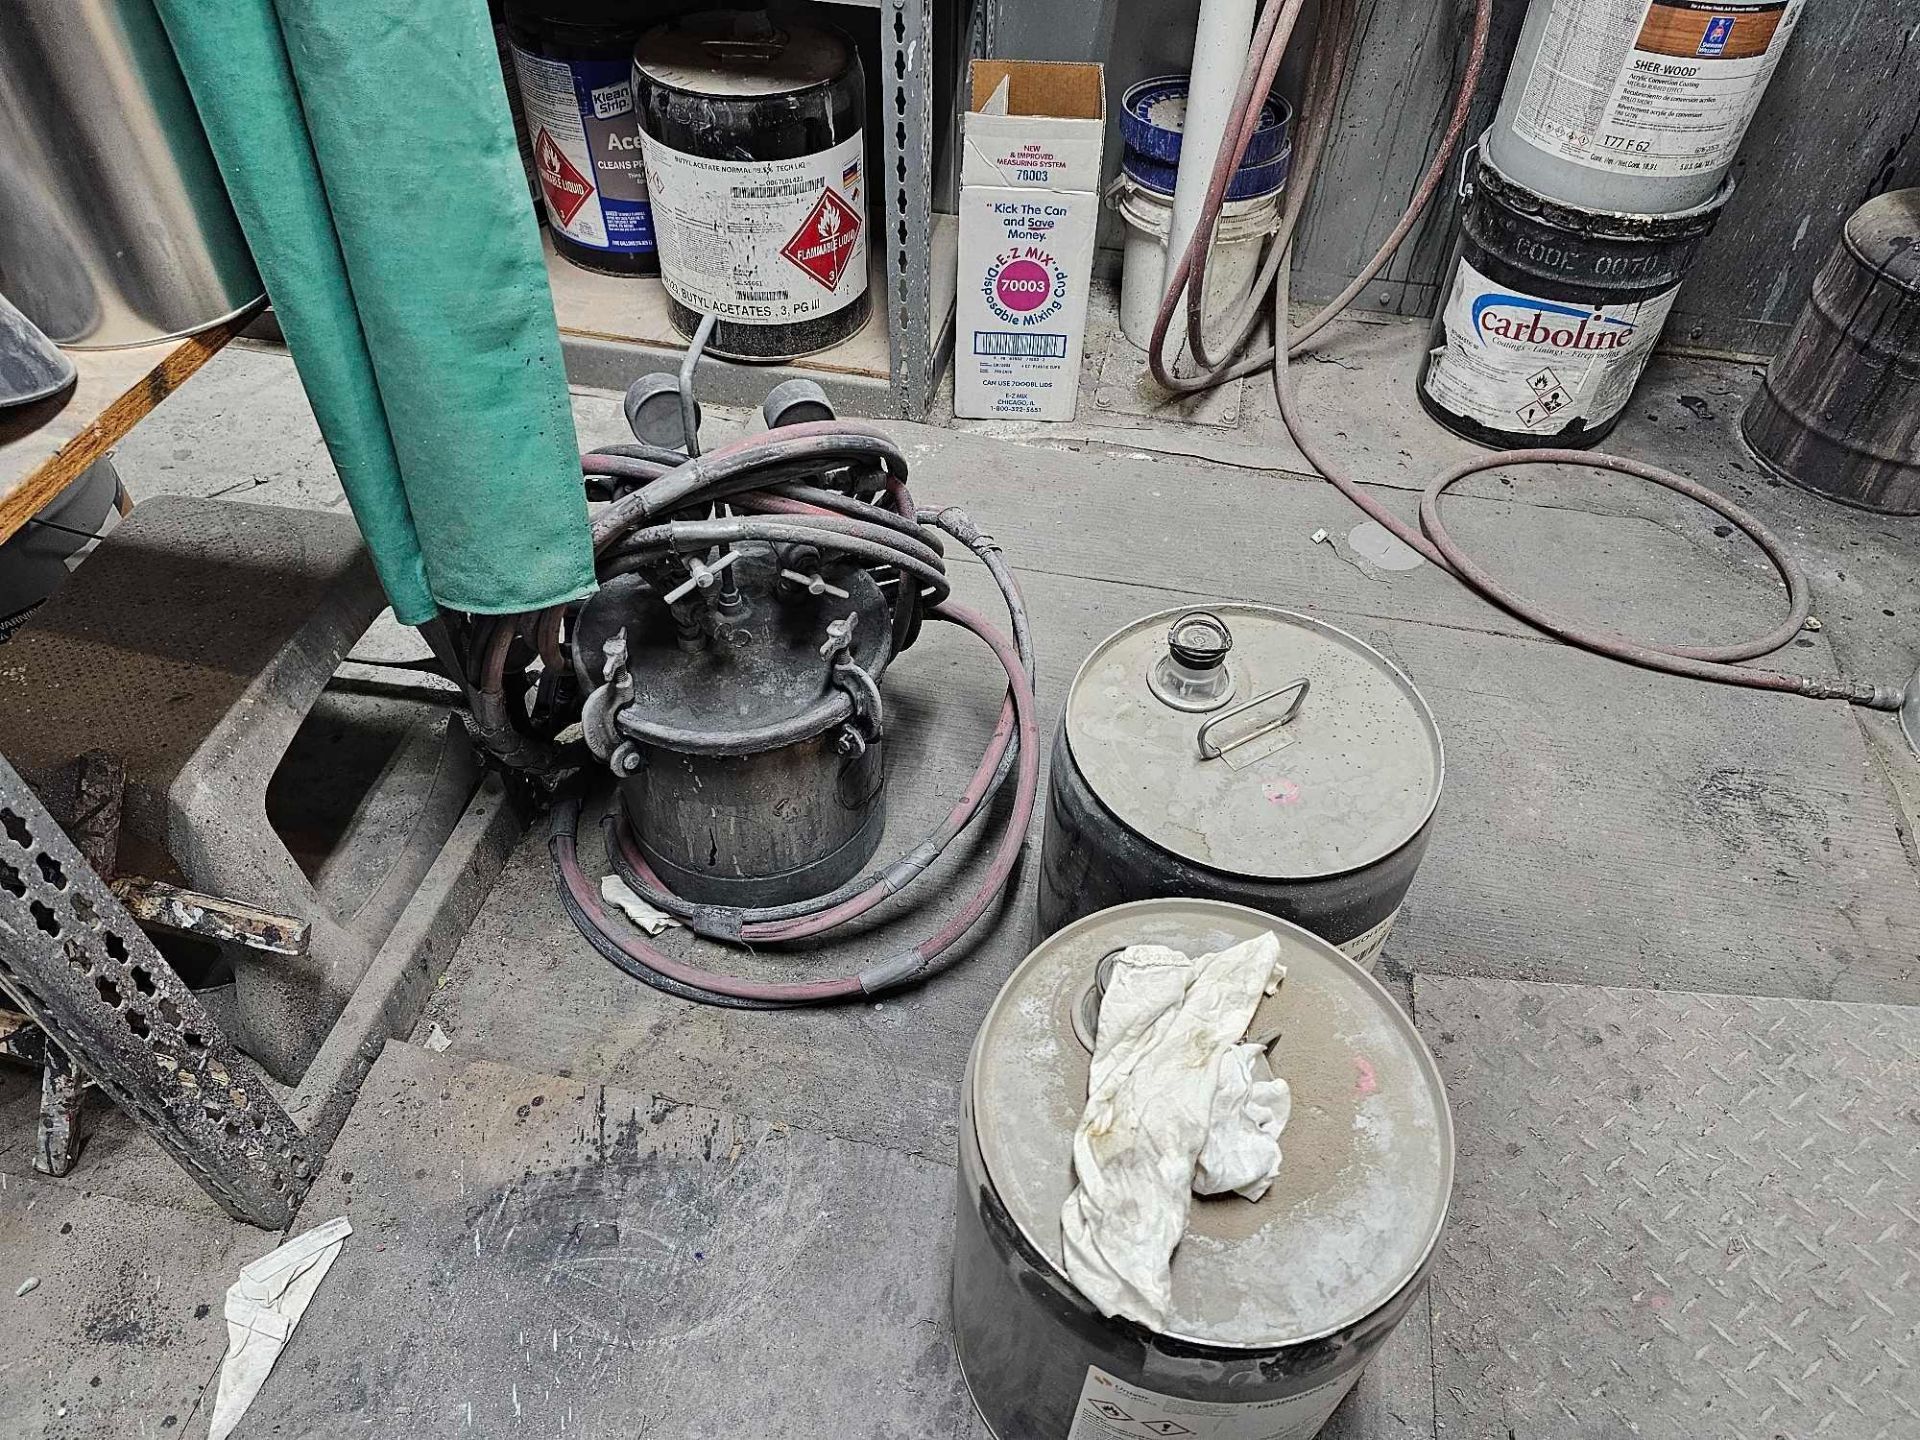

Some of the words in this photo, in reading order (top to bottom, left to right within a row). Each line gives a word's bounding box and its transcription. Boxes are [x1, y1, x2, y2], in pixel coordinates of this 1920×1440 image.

[593, 87, 629, 104] Klean
[1603, 134, 1625, 147] T77
[1626, 140, 1635, 150] F
[1635, 141, 1650, 152] 62
[1017, 152, 1054, 160] IMPROVED
[597, 161, 632, 170] CLEANS
[692, 161, 720, 172] ACETATE
[721, 166, 752, 174] NORMAL
[996, 158, 1038, 168] MEASURING
[1039, 160, 1067, 169] SYSTEM
[1016, 169, 1049, 182] 70003
[561, 179, 585, 196] LIQUID
[994, 203, 1018, 214] Kick
[1021, 204, 1042, 215] The
[1044, 205, 1067, 216] Can
[1003, 216, 1025, 227] and
[1027, 217, 1055, 229] Save
[1007, 230, 1047, 242] Money.
[797, 238, 838, 261] FLAMMABLE
[1516, 238, 1580, 270] CODE
[1024, 246, 1054, 267] MIX
[828, 270, 835, 281] 3
[1001, 279, 1046, 293] 70003
[681, 287, 711, 308] BUTYL
[712, 301, 772, 317] ACETATES
[780, 305, 790, 317] 3,
[793, 301, 809, 314] PG
[980, 267, 1020, 326] Disposable
[1022, 300, 1063, 327] Mixing
[1053, 272, 1069, 298] Cup
[1492, 336, 1525, 352] Coatings
[1533, 345, 1564, 358] Linings
[1571, 350, 1620, 361] Fireproofing
[997, 399, 1028, 407] CHICAGO,
